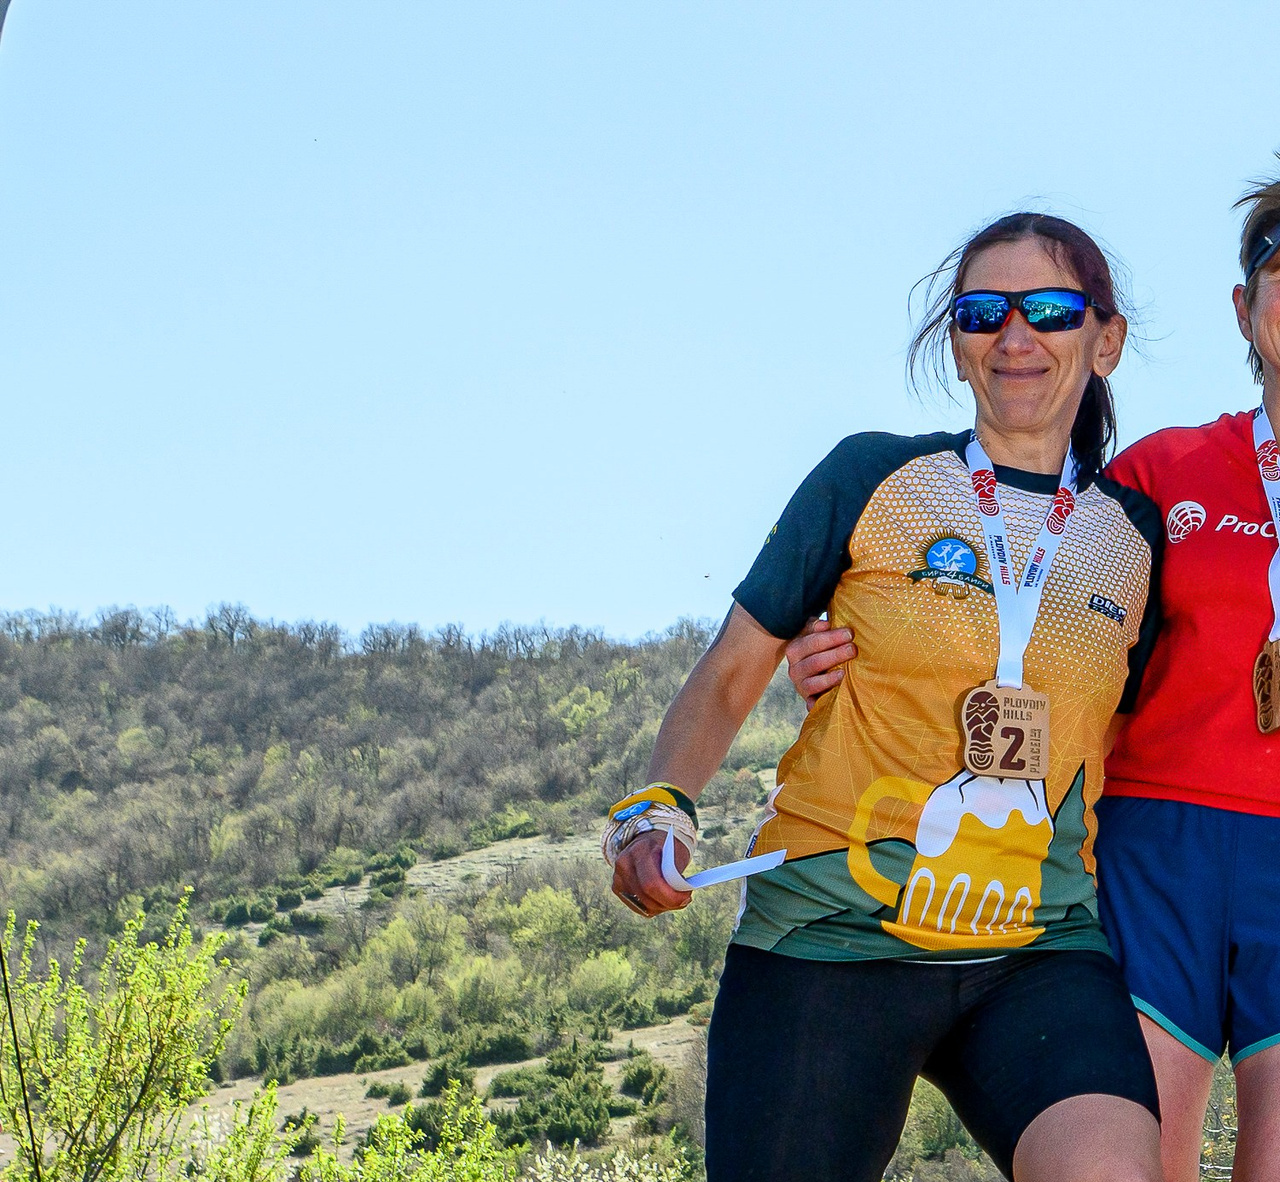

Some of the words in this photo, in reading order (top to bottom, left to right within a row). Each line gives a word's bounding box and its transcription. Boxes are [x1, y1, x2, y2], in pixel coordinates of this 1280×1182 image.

[1004, 696, 1046, 710] PLOVDIV
[1003, 710, 1033, 721] HILLS
[1000, 727, 1026, 771] 2
